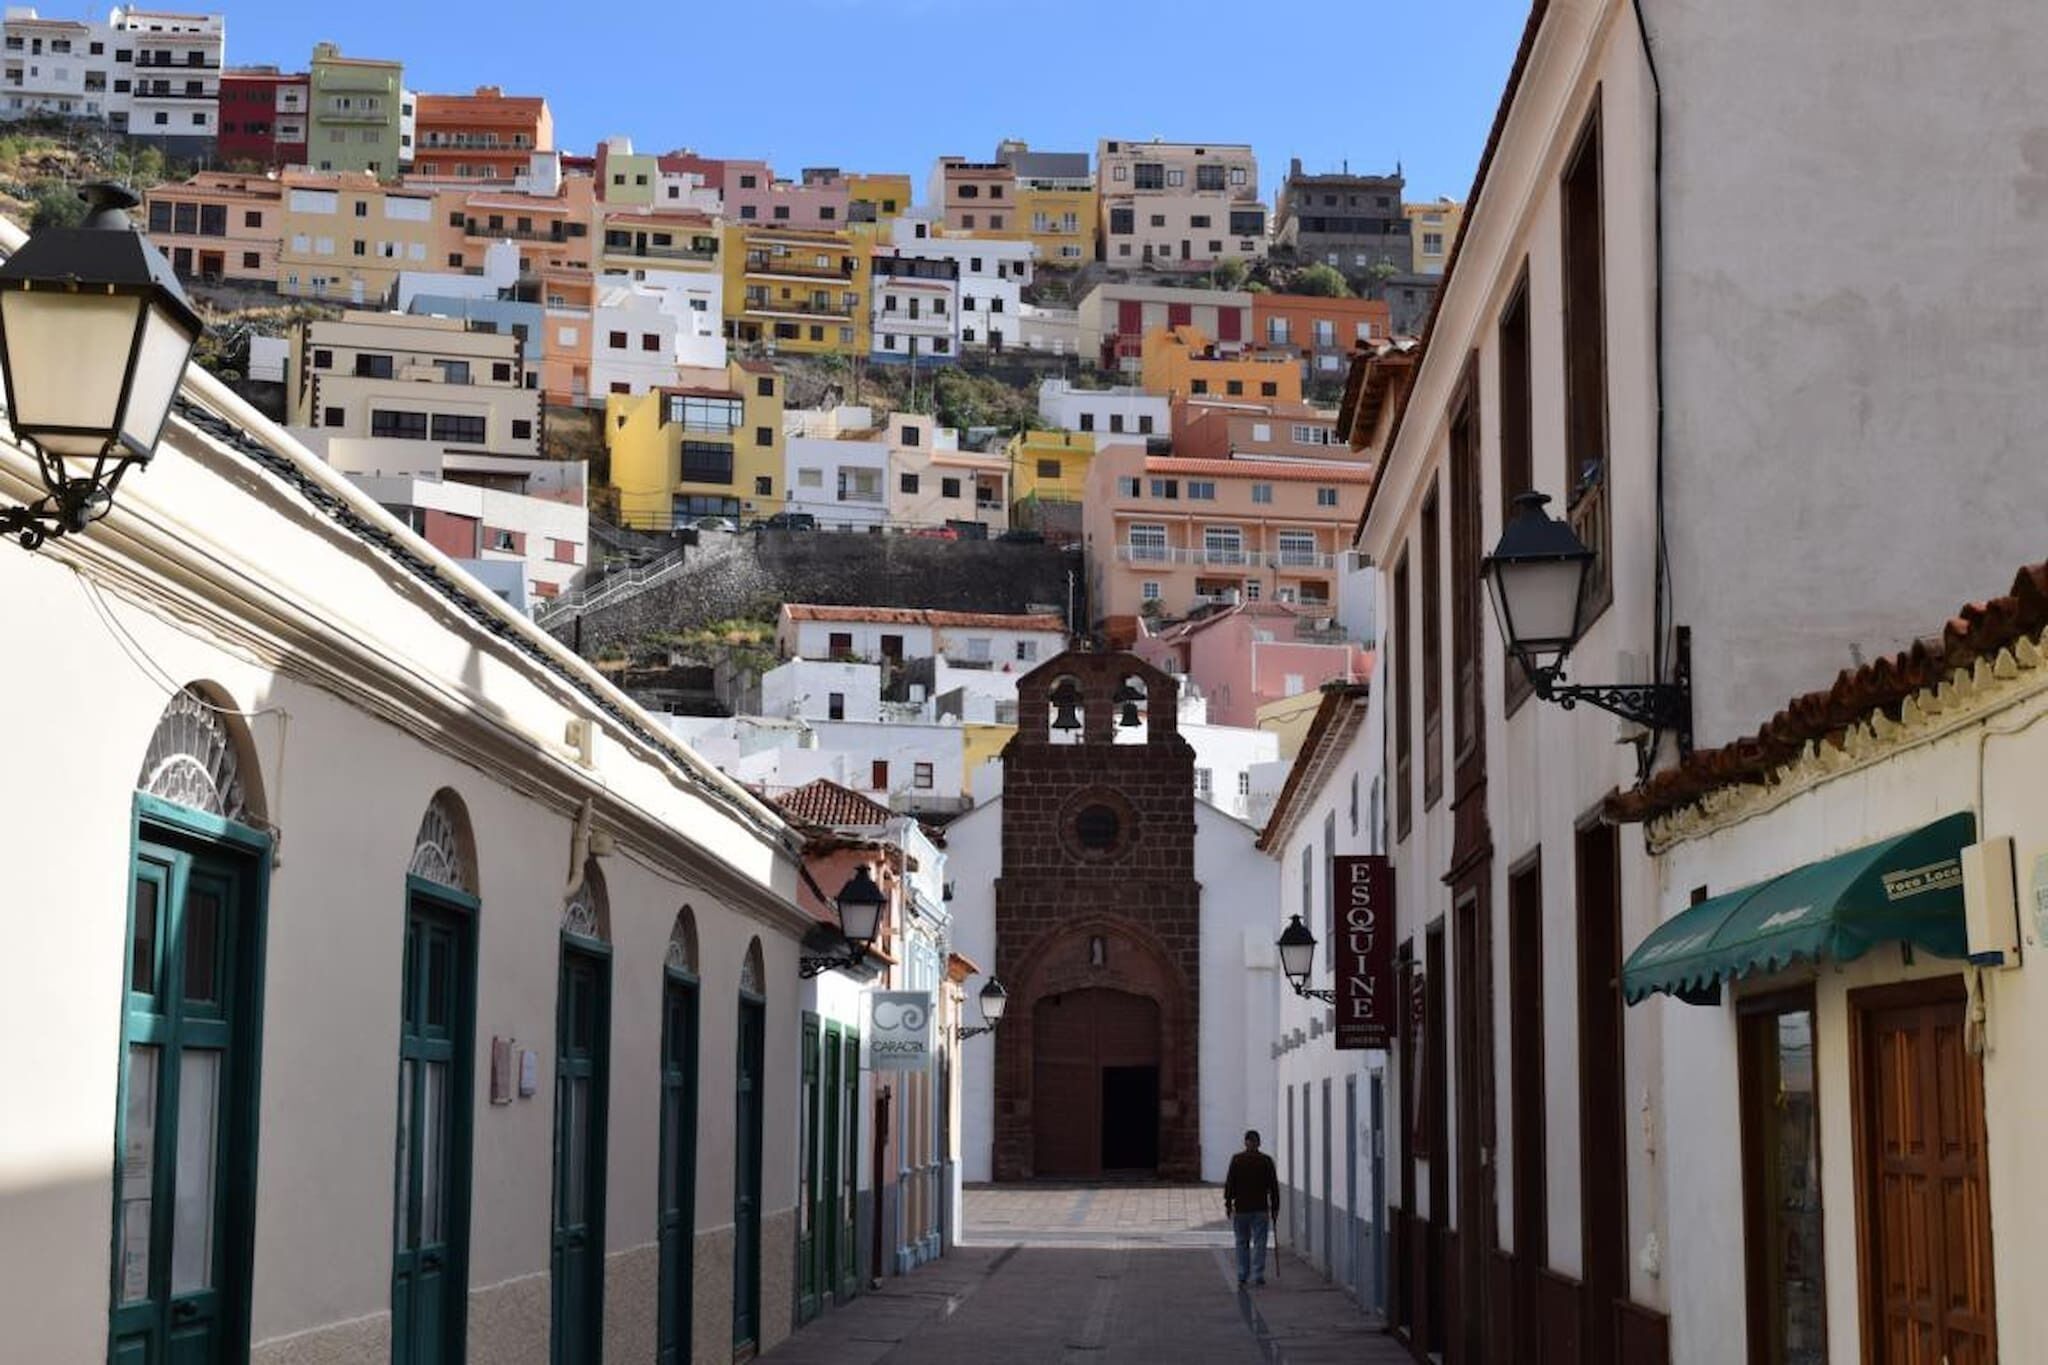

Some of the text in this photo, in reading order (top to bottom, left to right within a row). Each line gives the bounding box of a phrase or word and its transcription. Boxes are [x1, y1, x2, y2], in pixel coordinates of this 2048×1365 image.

[1887, 867, 1960, 893] Poco Loco
[1346, 862, 1375, 1018] ESQUINE
